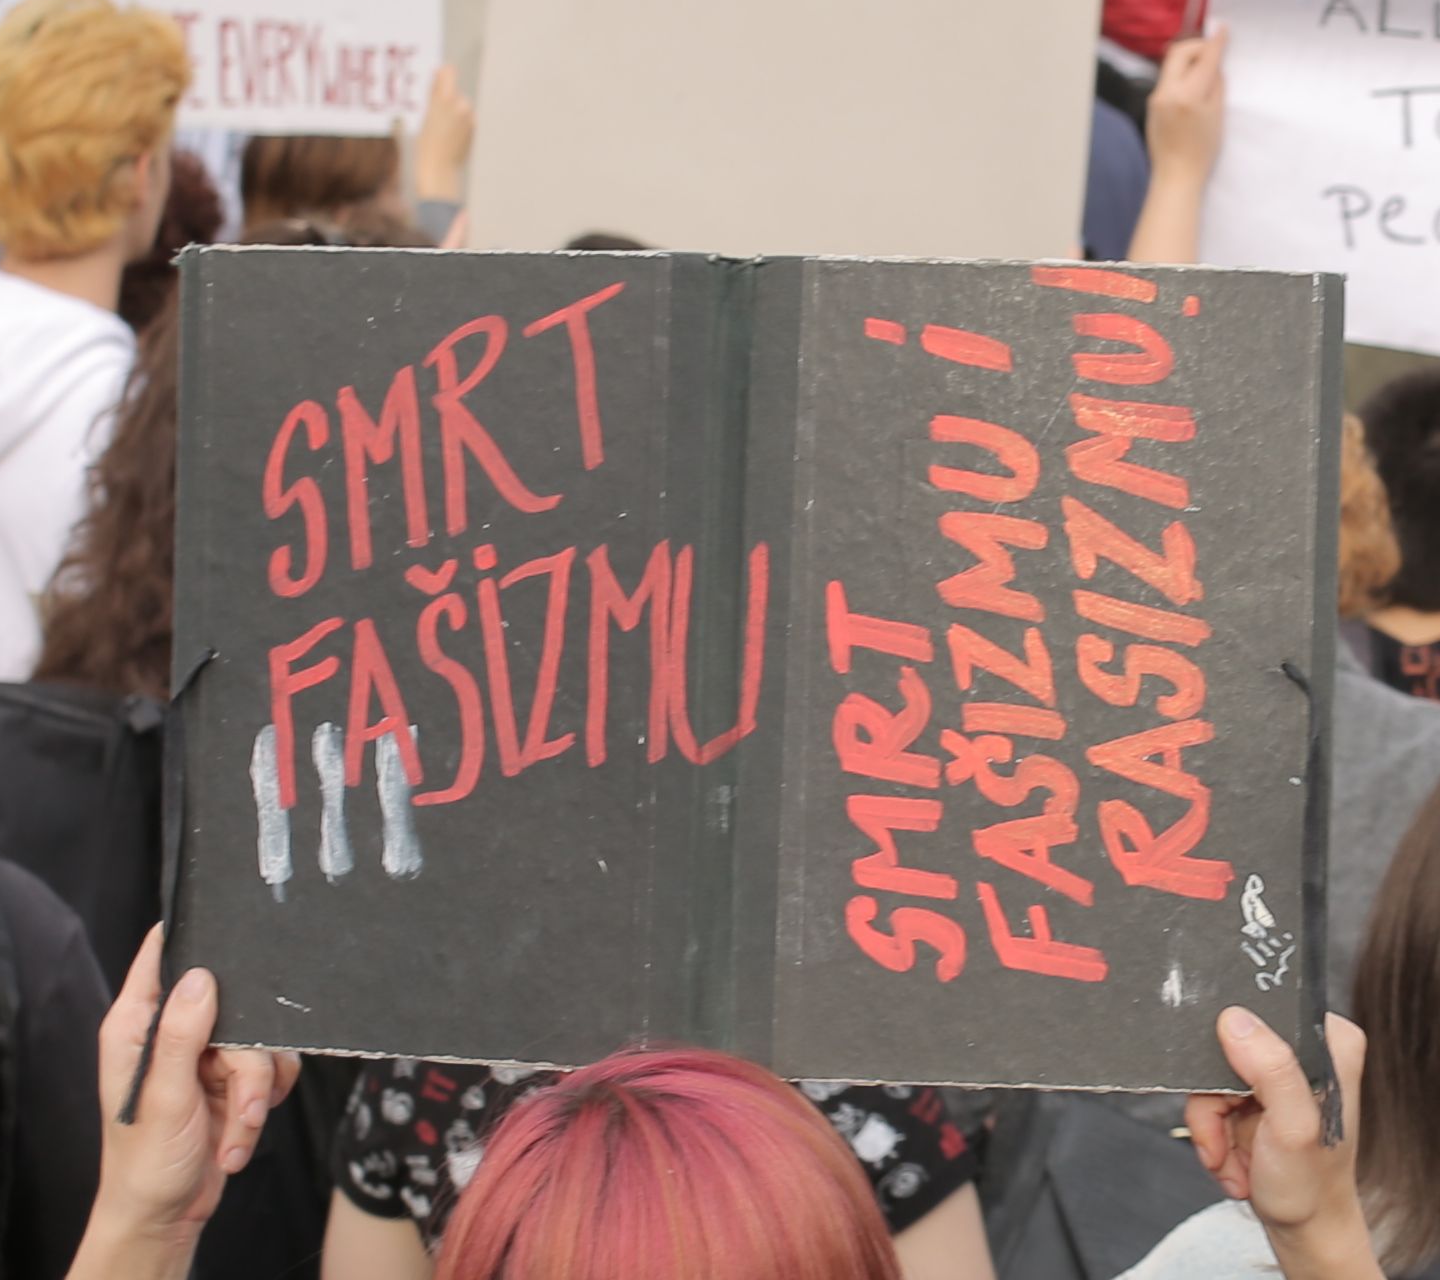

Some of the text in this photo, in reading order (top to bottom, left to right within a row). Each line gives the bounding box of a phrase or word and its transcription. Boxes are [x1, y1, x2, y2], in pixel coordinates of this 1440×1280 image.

[262, 282, 627, 598] SMRT
[269, 542, 769, 810] FAŠIZMU
[824, 579, 966, 983] SMRT
[927, 414, 1108, 983] FAŠIZMU
